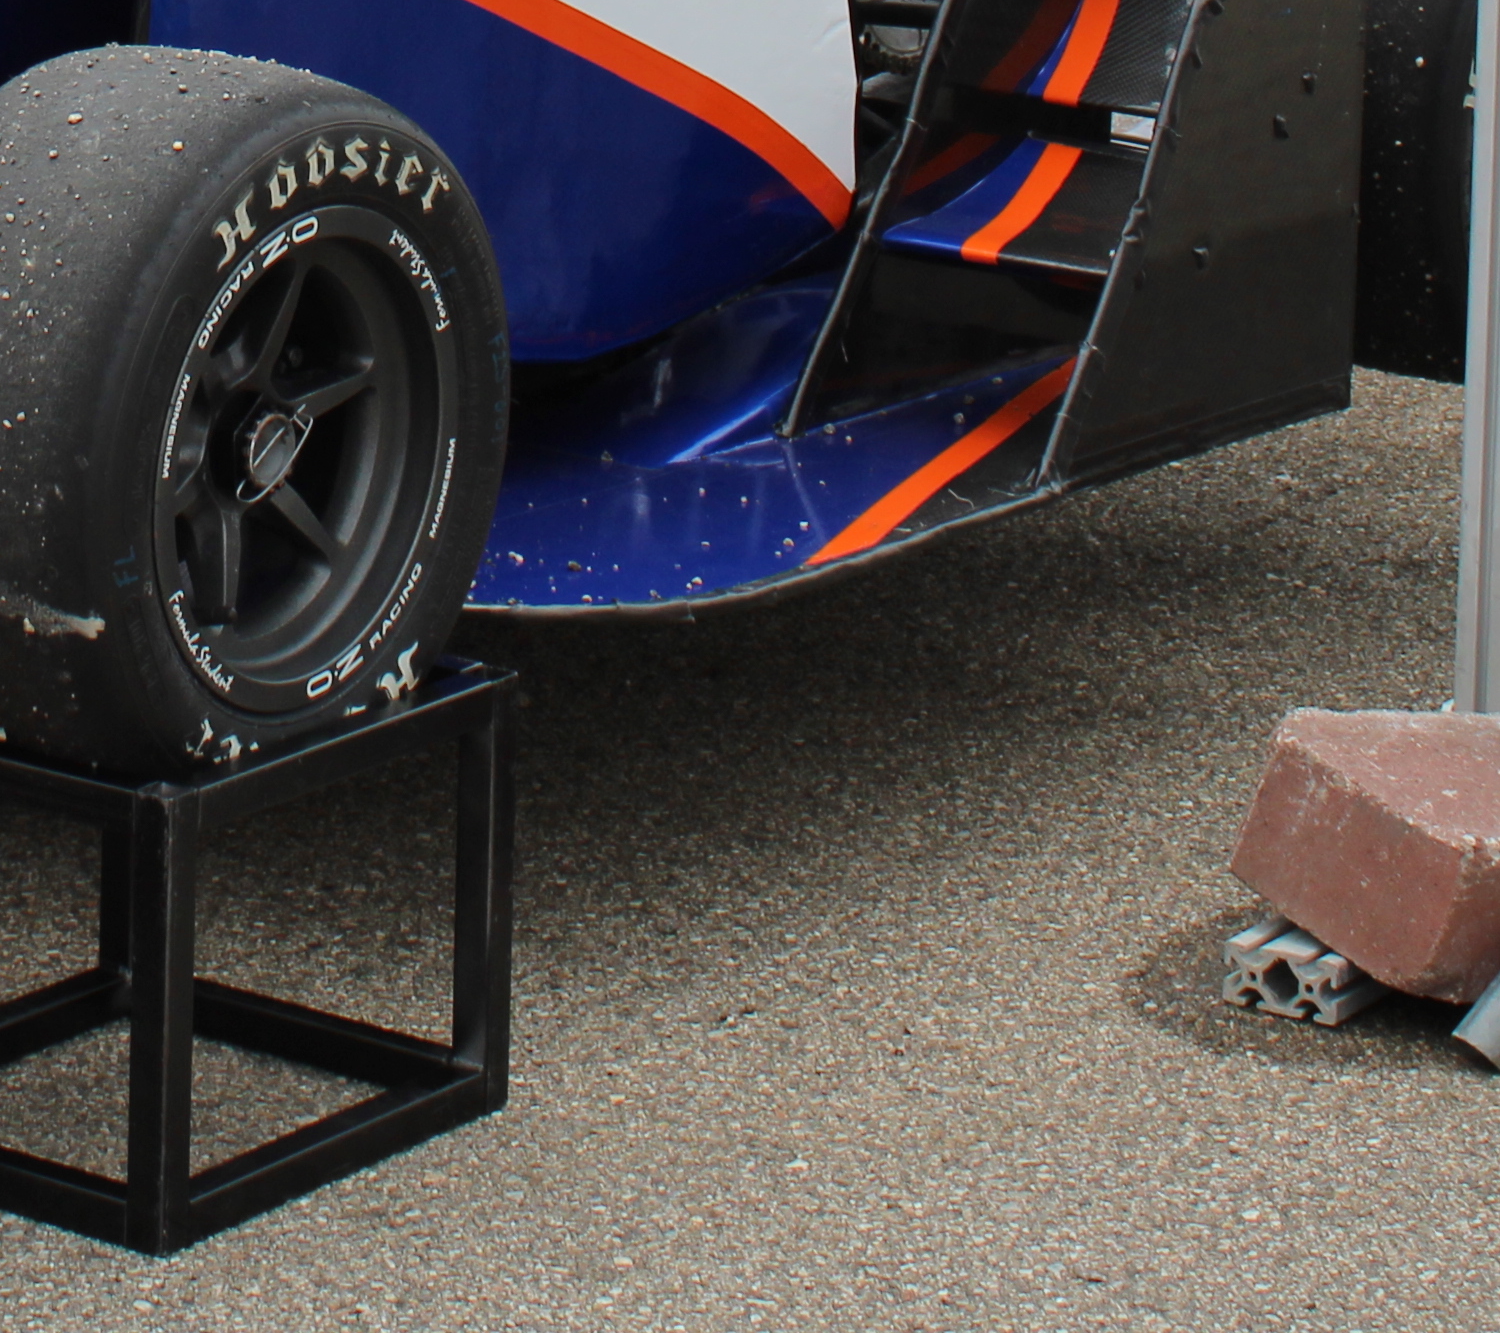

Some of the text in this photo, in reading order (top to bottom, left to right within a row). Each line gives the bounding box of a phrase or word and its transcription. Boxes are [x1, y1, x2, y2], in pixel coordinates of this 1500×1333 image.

[213, 135, 450, 273] Hoosier
[198, 261, 255, 349] RACING
[162, 374, 190, 479] MAGNESIUM
[429, 438, 456, 538] MAGNESIUM
[369, 562, 423, 650] RACING
